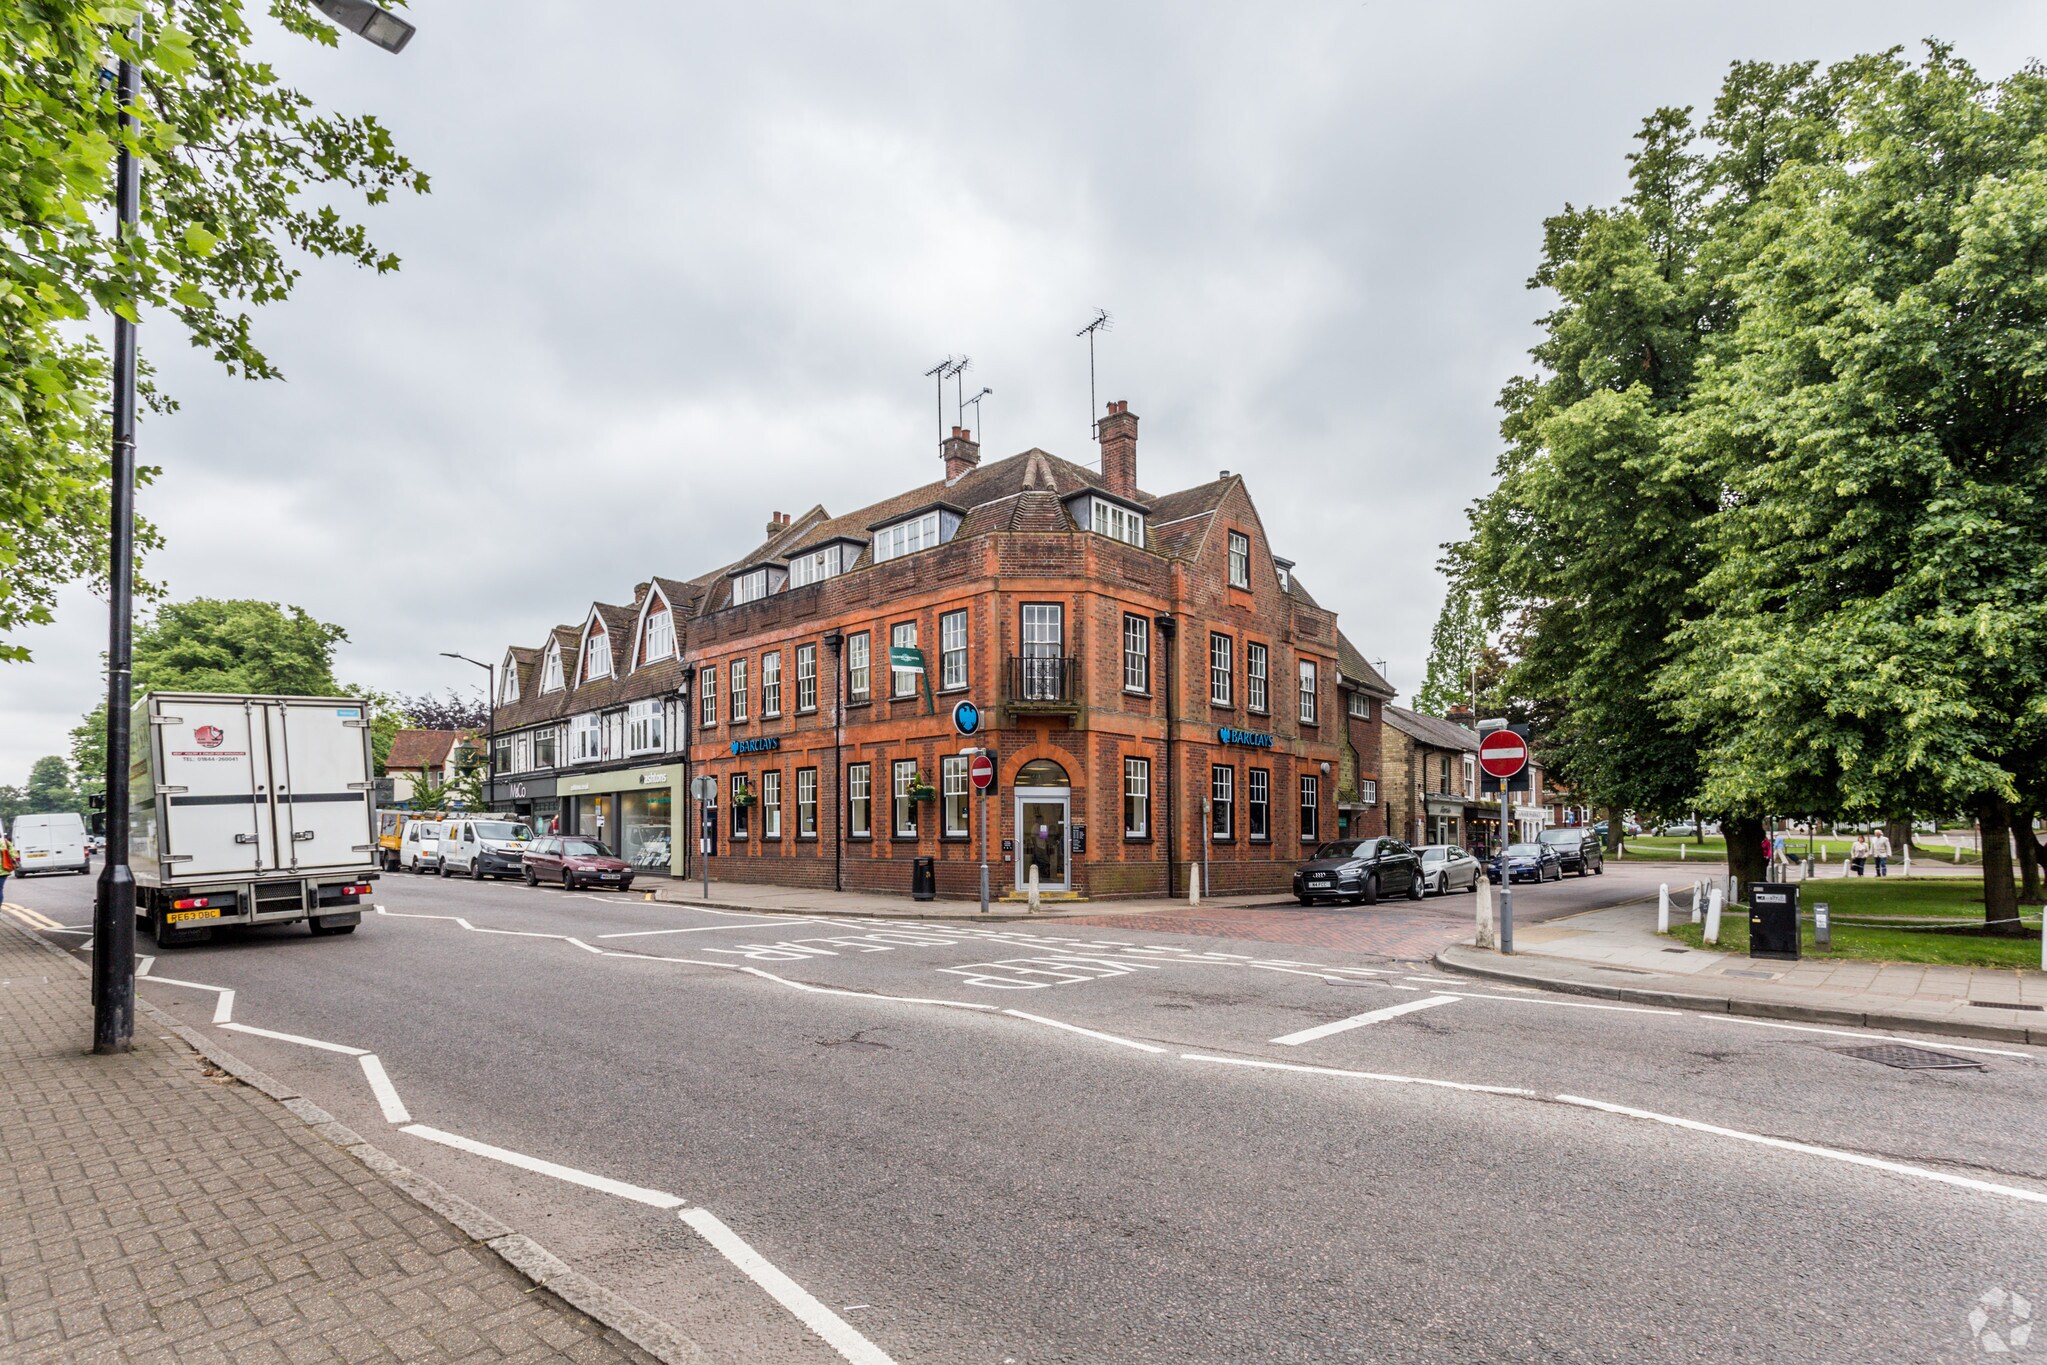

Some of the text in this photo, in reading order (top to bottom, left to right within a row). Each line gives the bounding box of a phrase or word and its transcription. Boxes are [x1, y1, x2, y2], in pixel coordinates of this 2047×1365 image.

[739, 738, 778, 753] BARCLAYS
[1232, 730, 1275, 747] BARCLAYS
[643, 772, 667, 784] ashtons
[509, 782, 527, 798] M&Co
[171, 912, 196, 921] RE63
[701, 932, 959, 961] CLEAR
[935, 956, 1161, 989] KEEP
